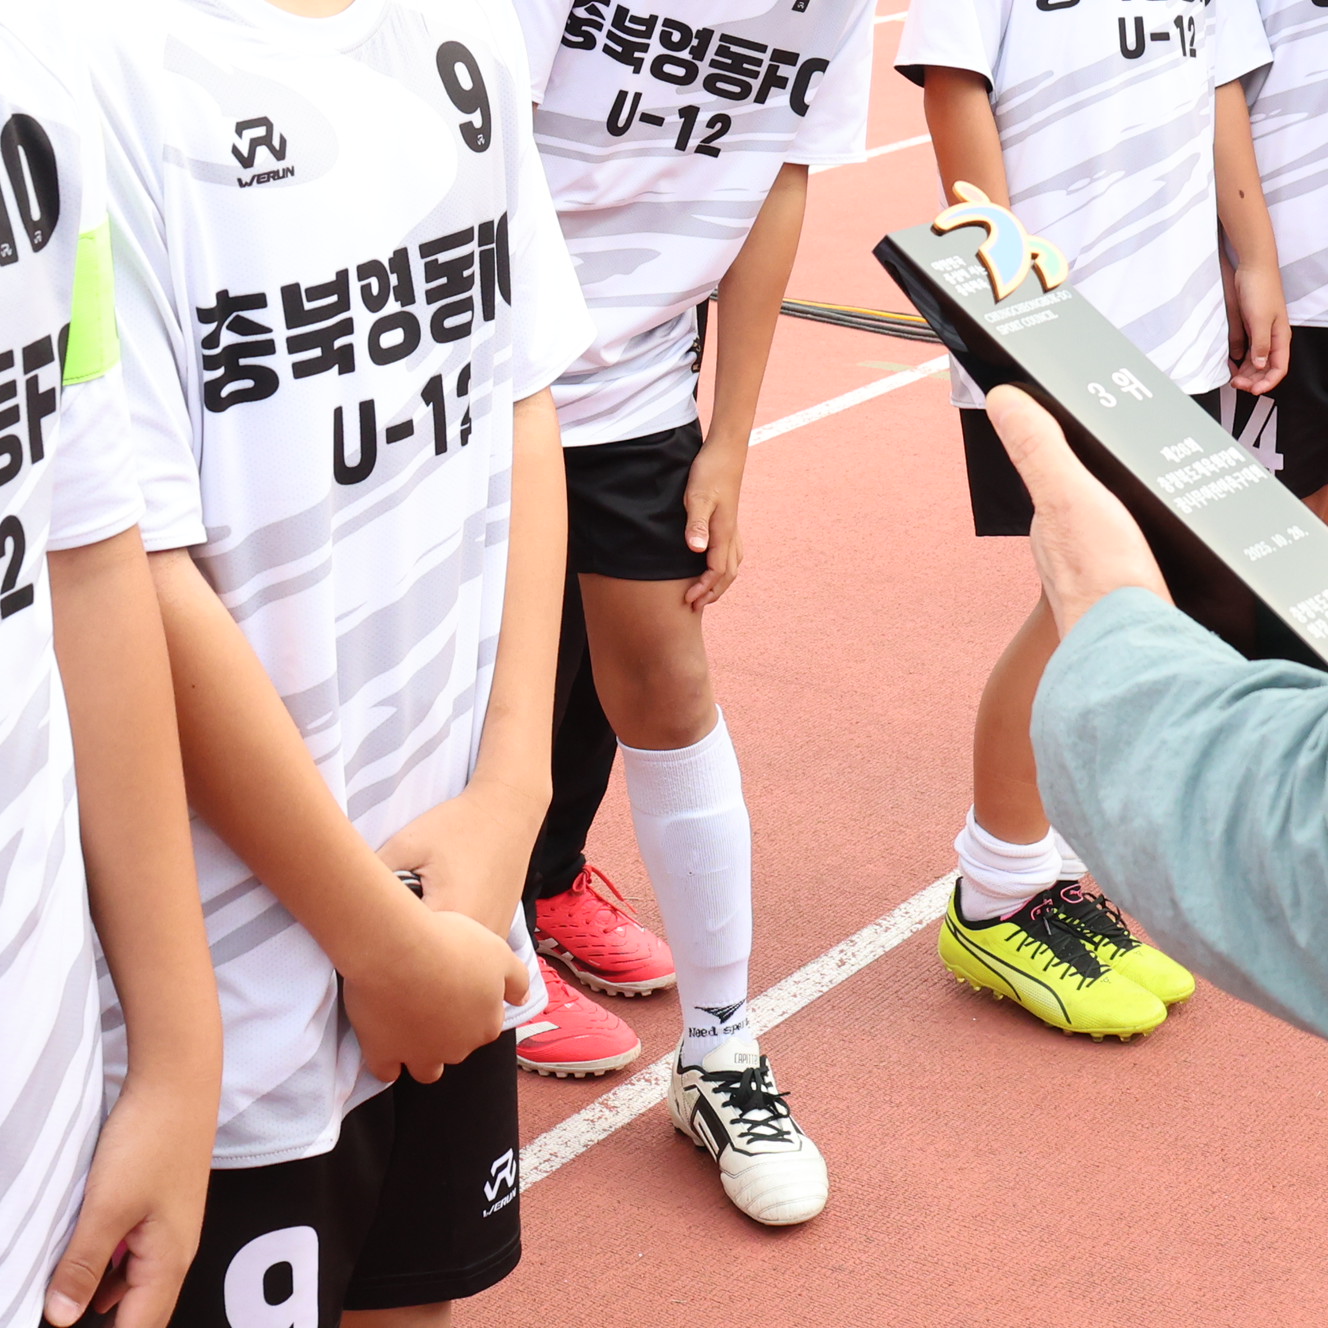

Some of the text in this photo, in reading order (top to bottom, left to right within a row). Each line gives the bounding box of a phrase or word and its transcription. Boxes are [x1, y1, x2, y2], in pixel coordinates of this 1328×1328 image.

[436, 40, 492, 153] 9
[606, 89, 732, 159] U-12
[237, 165, 295, 189] WERUN
[1087, 367, 1154, 408] 3 위
